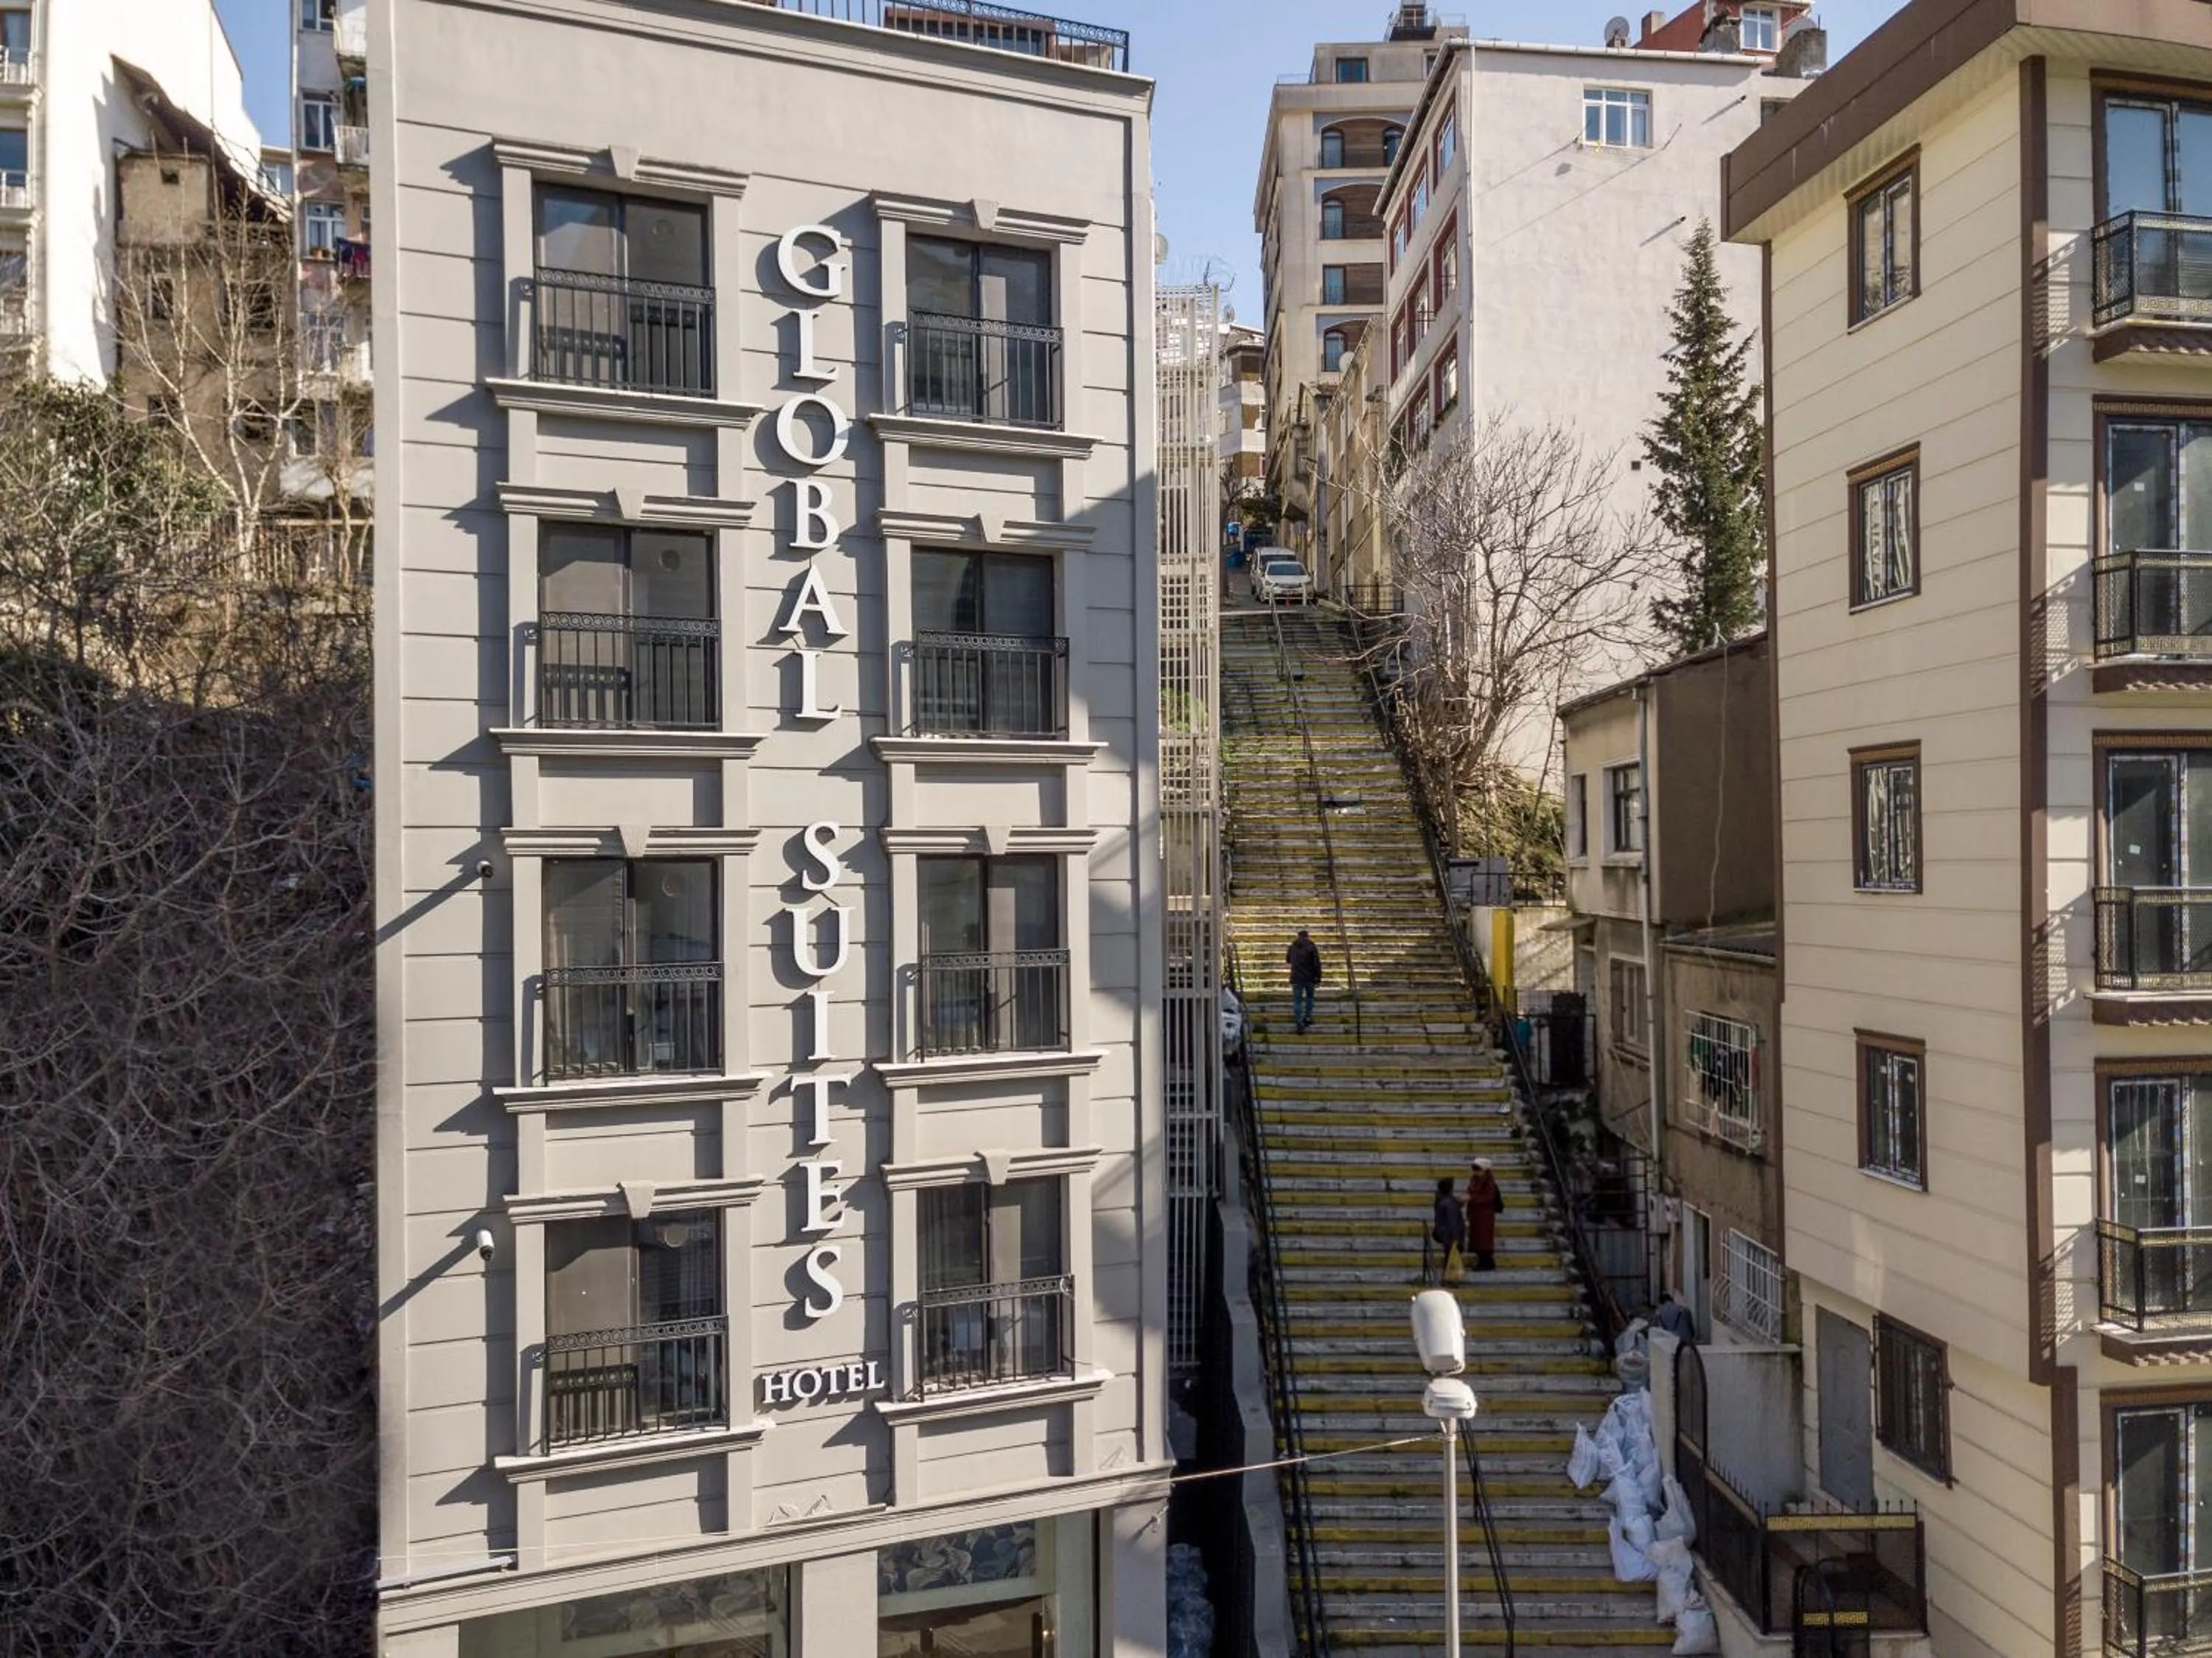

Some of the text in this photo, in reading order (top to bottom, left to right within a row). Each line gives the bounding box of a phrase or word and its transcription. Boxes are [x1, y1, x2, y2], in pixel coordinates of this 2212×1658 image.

[776, 224, 856, 1318] GLOBAL SUITES
[762, 1361, 885, 1404] HOTEL
